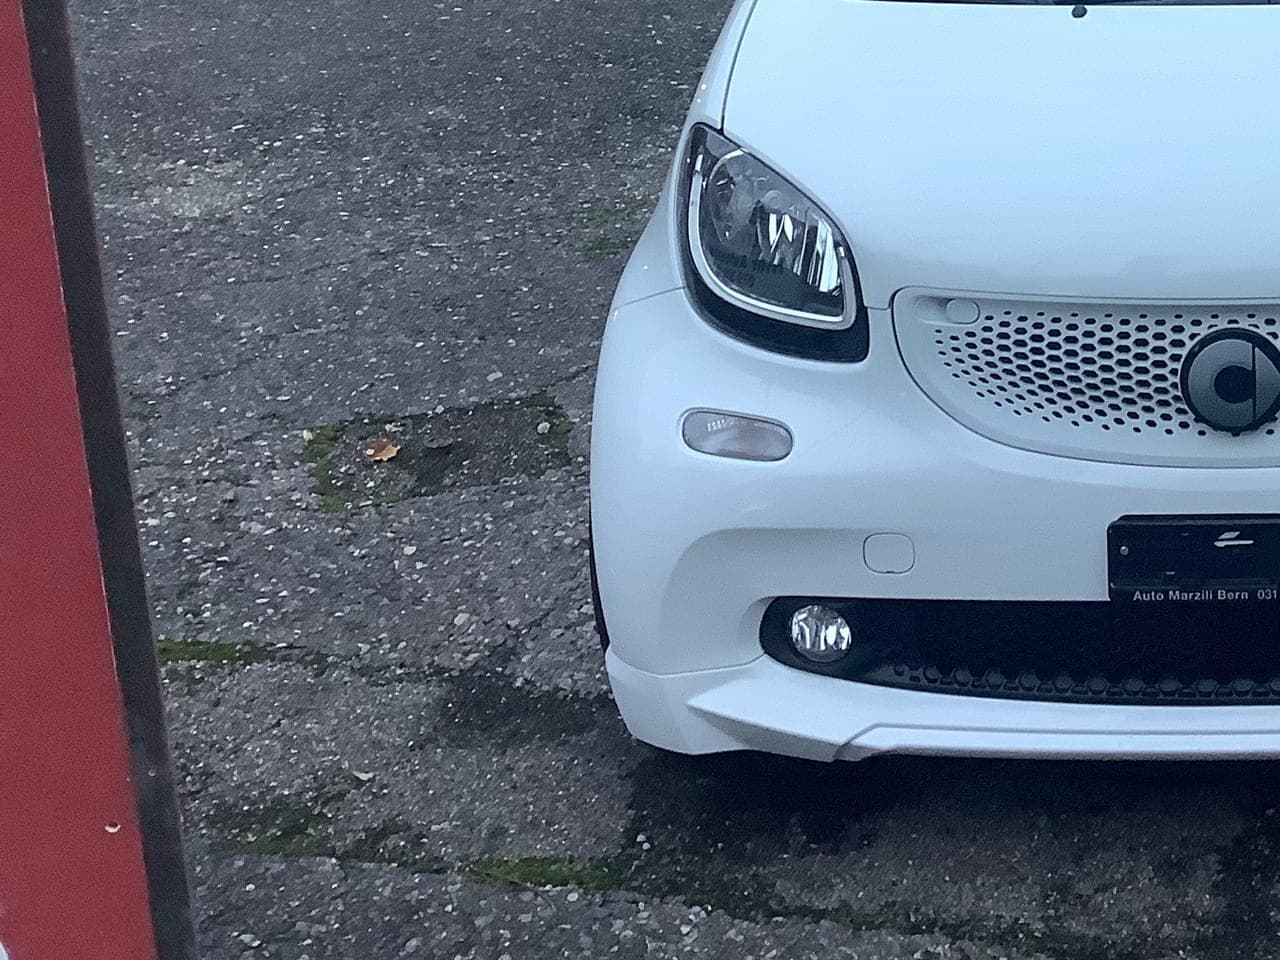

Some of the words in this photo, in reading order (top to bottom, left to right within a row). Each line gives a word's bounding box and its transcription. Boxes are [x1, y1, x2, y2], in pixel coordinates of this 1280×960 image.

[1133, 590, 1164, 601] Auto
[1168, 589, 1213, 601] Marzili
[1217, 589, 1249, 601] Bern
[1257, 589, 1277, 600] 031
